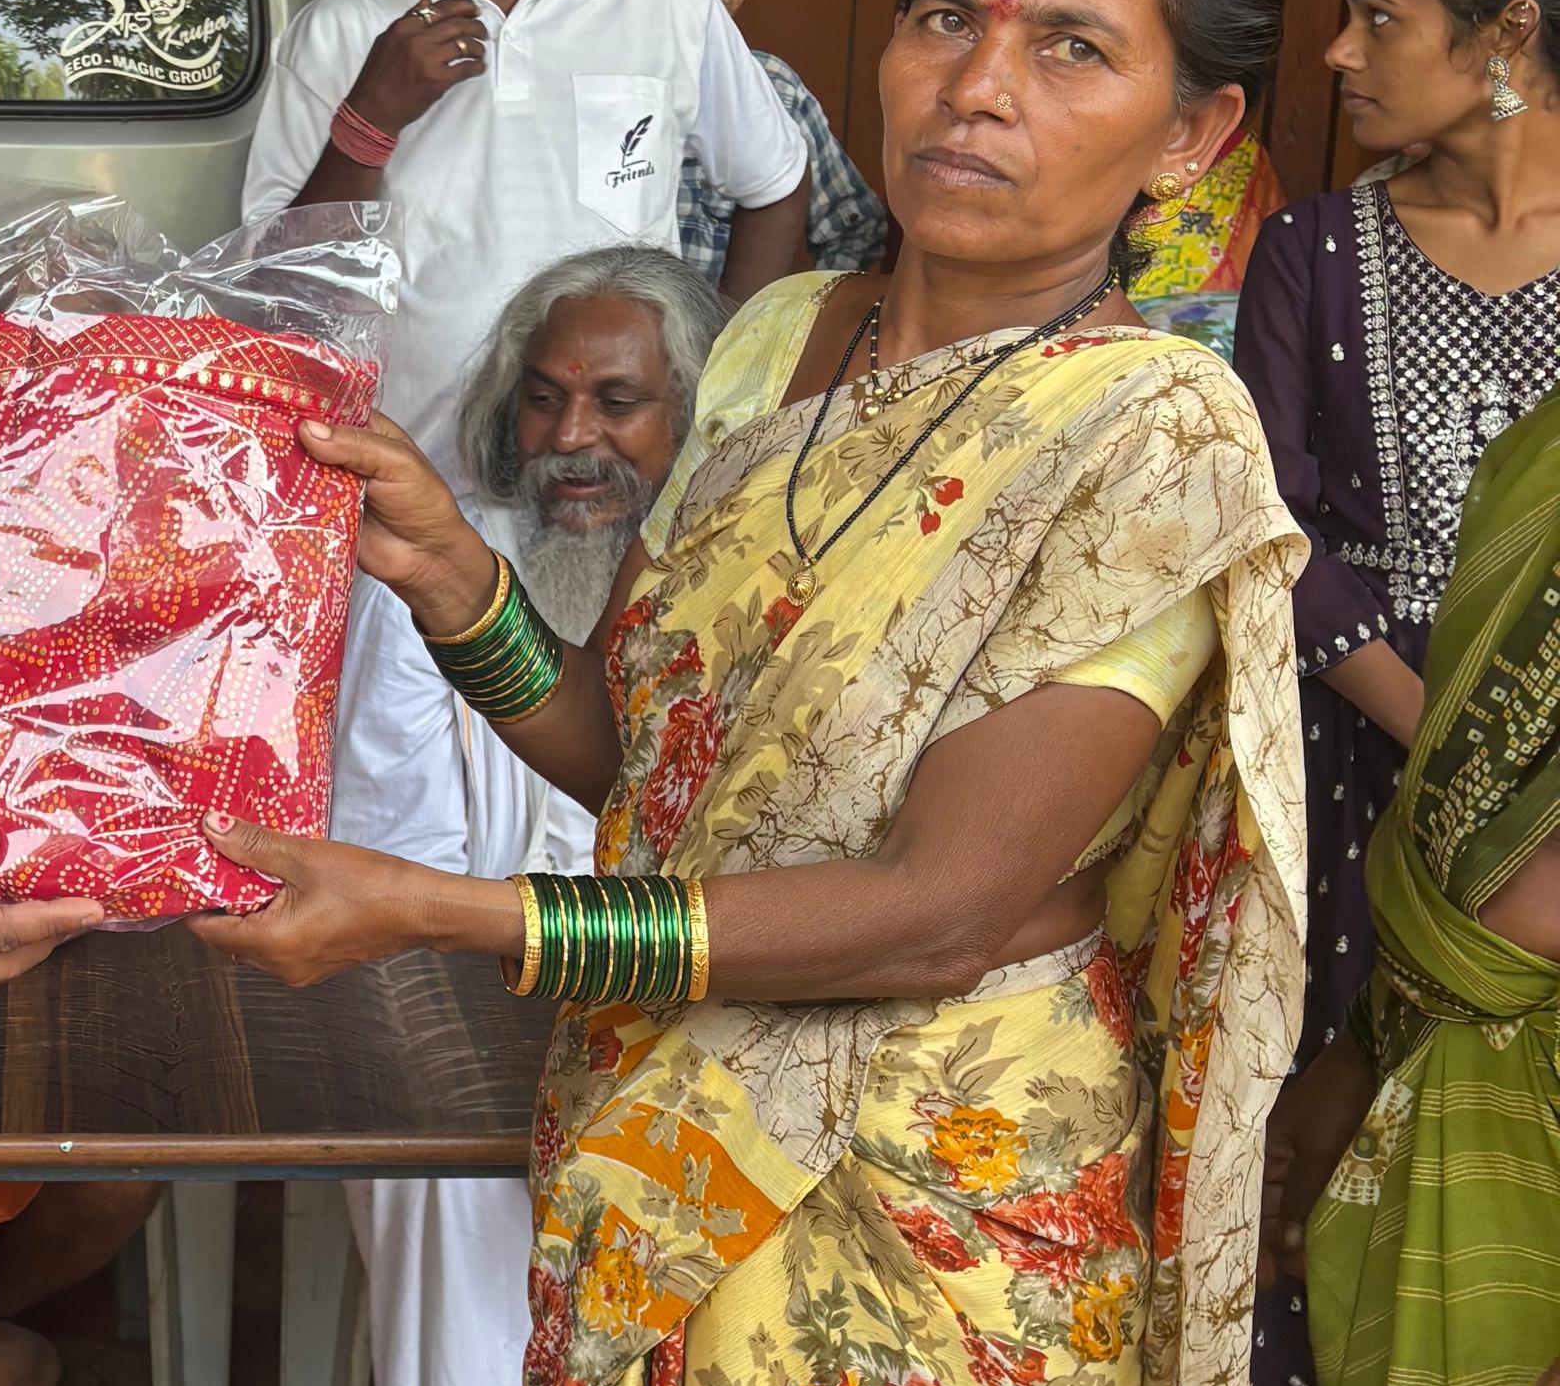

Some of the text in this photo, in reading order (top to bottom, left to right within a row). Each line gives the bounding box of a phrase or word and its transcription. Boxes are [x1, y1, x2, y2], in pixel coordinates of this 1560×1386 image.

[157, 15, 232, 51] Krupa
[168, 61, 222, 83] GROUP
[605, 160, 655, 188] Friends
